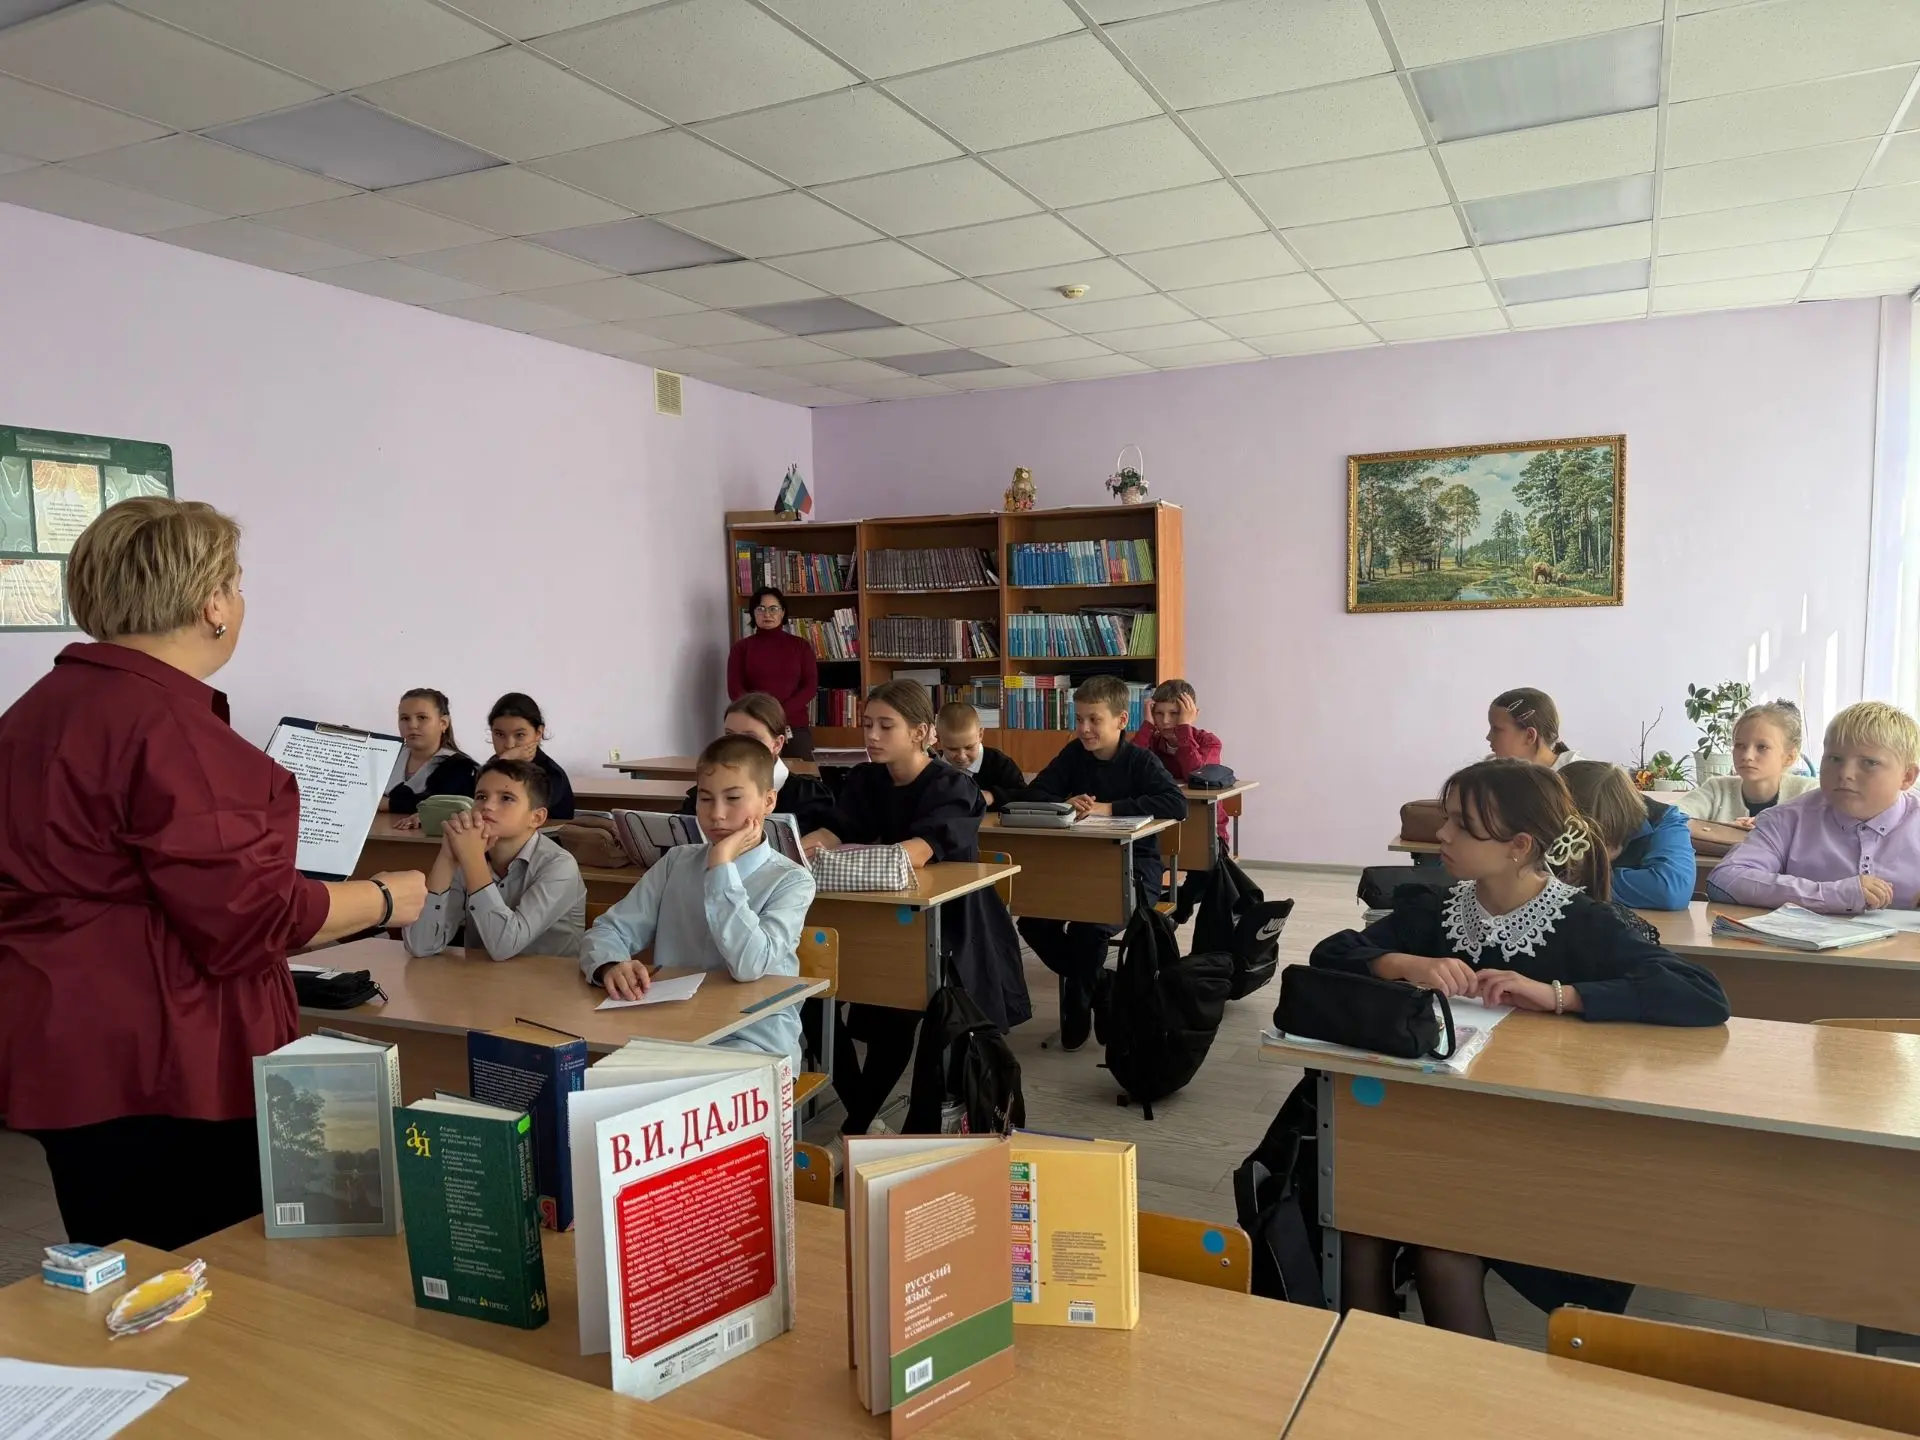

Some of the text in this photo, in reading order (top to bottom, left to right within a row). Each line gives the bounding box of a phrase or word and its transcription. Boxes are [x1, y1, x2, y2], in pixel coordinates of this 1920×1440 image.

[610, 1087, 769, 1174] В.И. ДАЛЬ
[781, 1120, 793, 1171] ДАЛЬ
[904, 1263, 951, 1293] РУССКИЙ
[904, 1285, 931, 1307] ЯЗЫК
